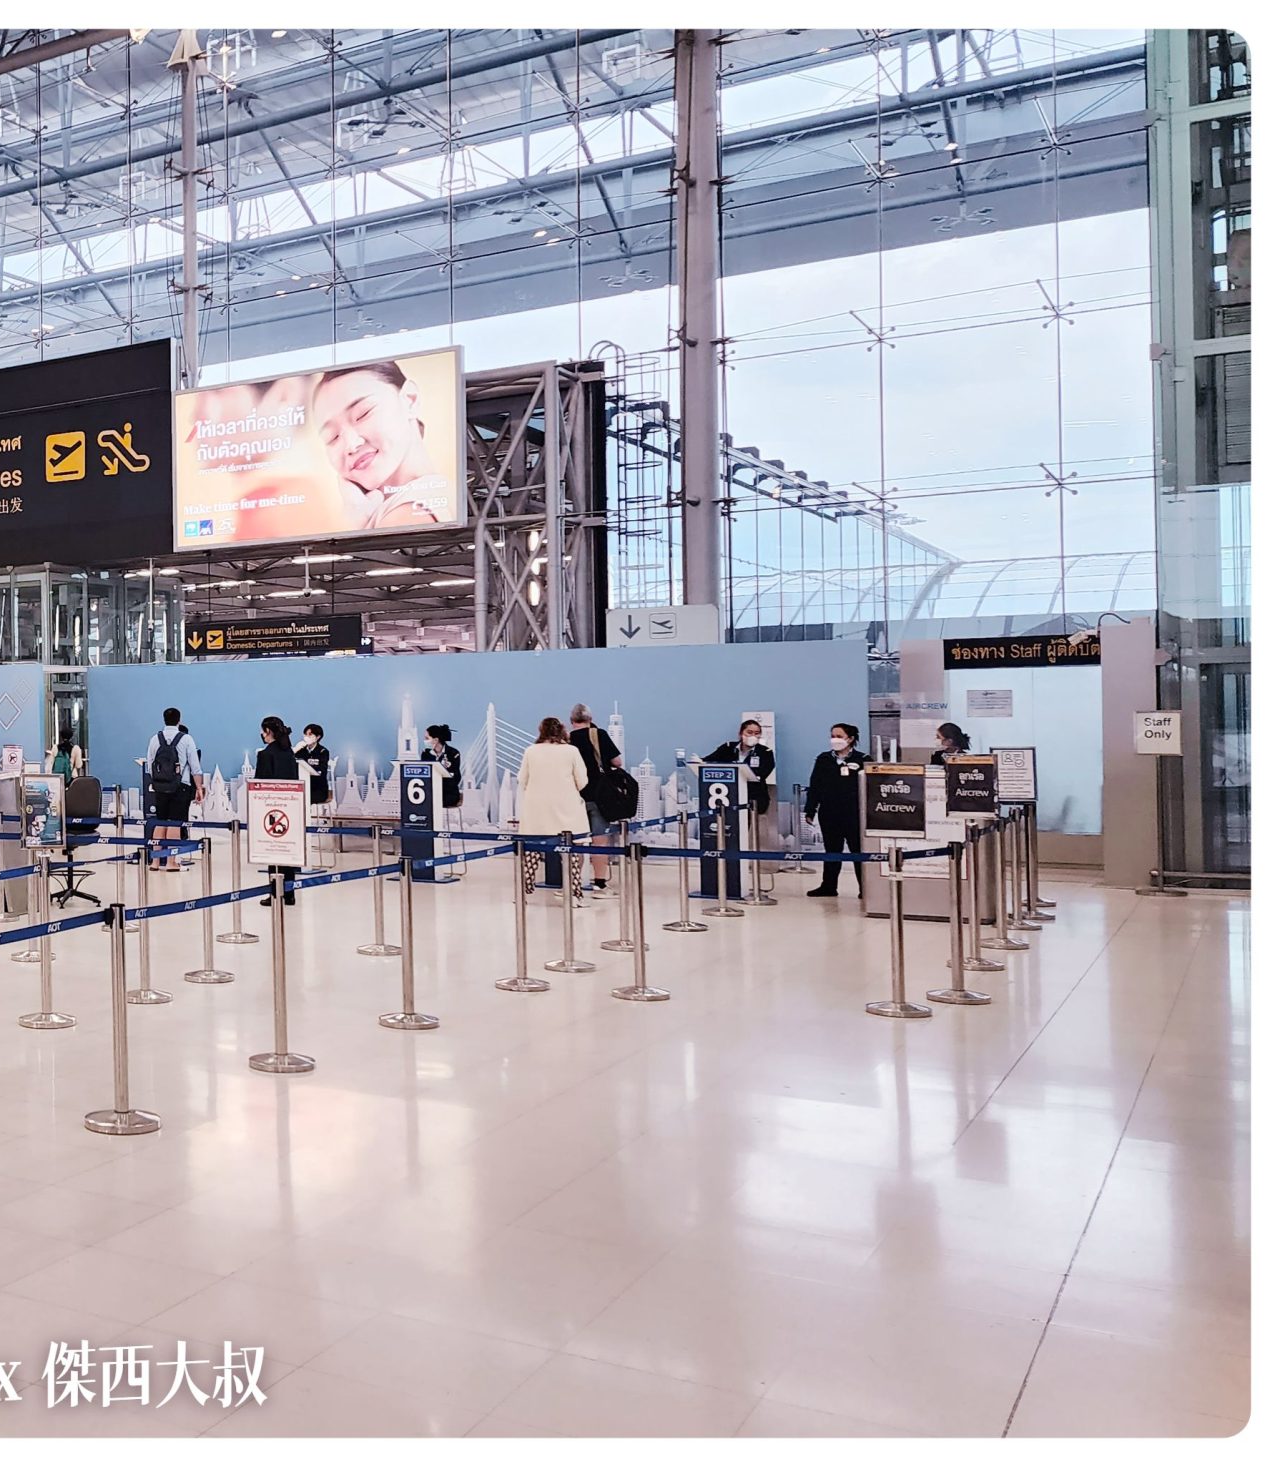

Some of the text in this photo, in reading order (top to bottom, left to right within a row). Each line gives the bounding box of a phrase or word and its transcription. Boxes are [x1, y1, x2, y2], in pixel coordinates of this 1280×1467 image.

[196, 406, 305, 439] ให้เวลาที่ควรให้
[197, 437, 292, 461] กับตัวคุณเอง
[183, 494, 306, 515] Make time for me-time
[226, 640, 294, 650] Domestic Departures
[951, 643, 1005, 660] ช่องทาง
[1010, 643, 1043, 658] Staff
[906, 702, 949, 710] AIRCREW
[1143, 717, 1173, 727] Staff
[1144, 729, 1172, 741] Only
[705, 771, 725, 779] STEP
[407, 778, 426, 805] 6
[708, 783, 730, 810] 8
[955, 788, 990, 798] Aircrew
[875, 802, 917, 813] Aircrew
[147, 838, 161, 846] AOT
[703, 850, 722, 858] AOT
[134, 908, 148, 919] AOT
[47, 922, 62, 933] AOT
